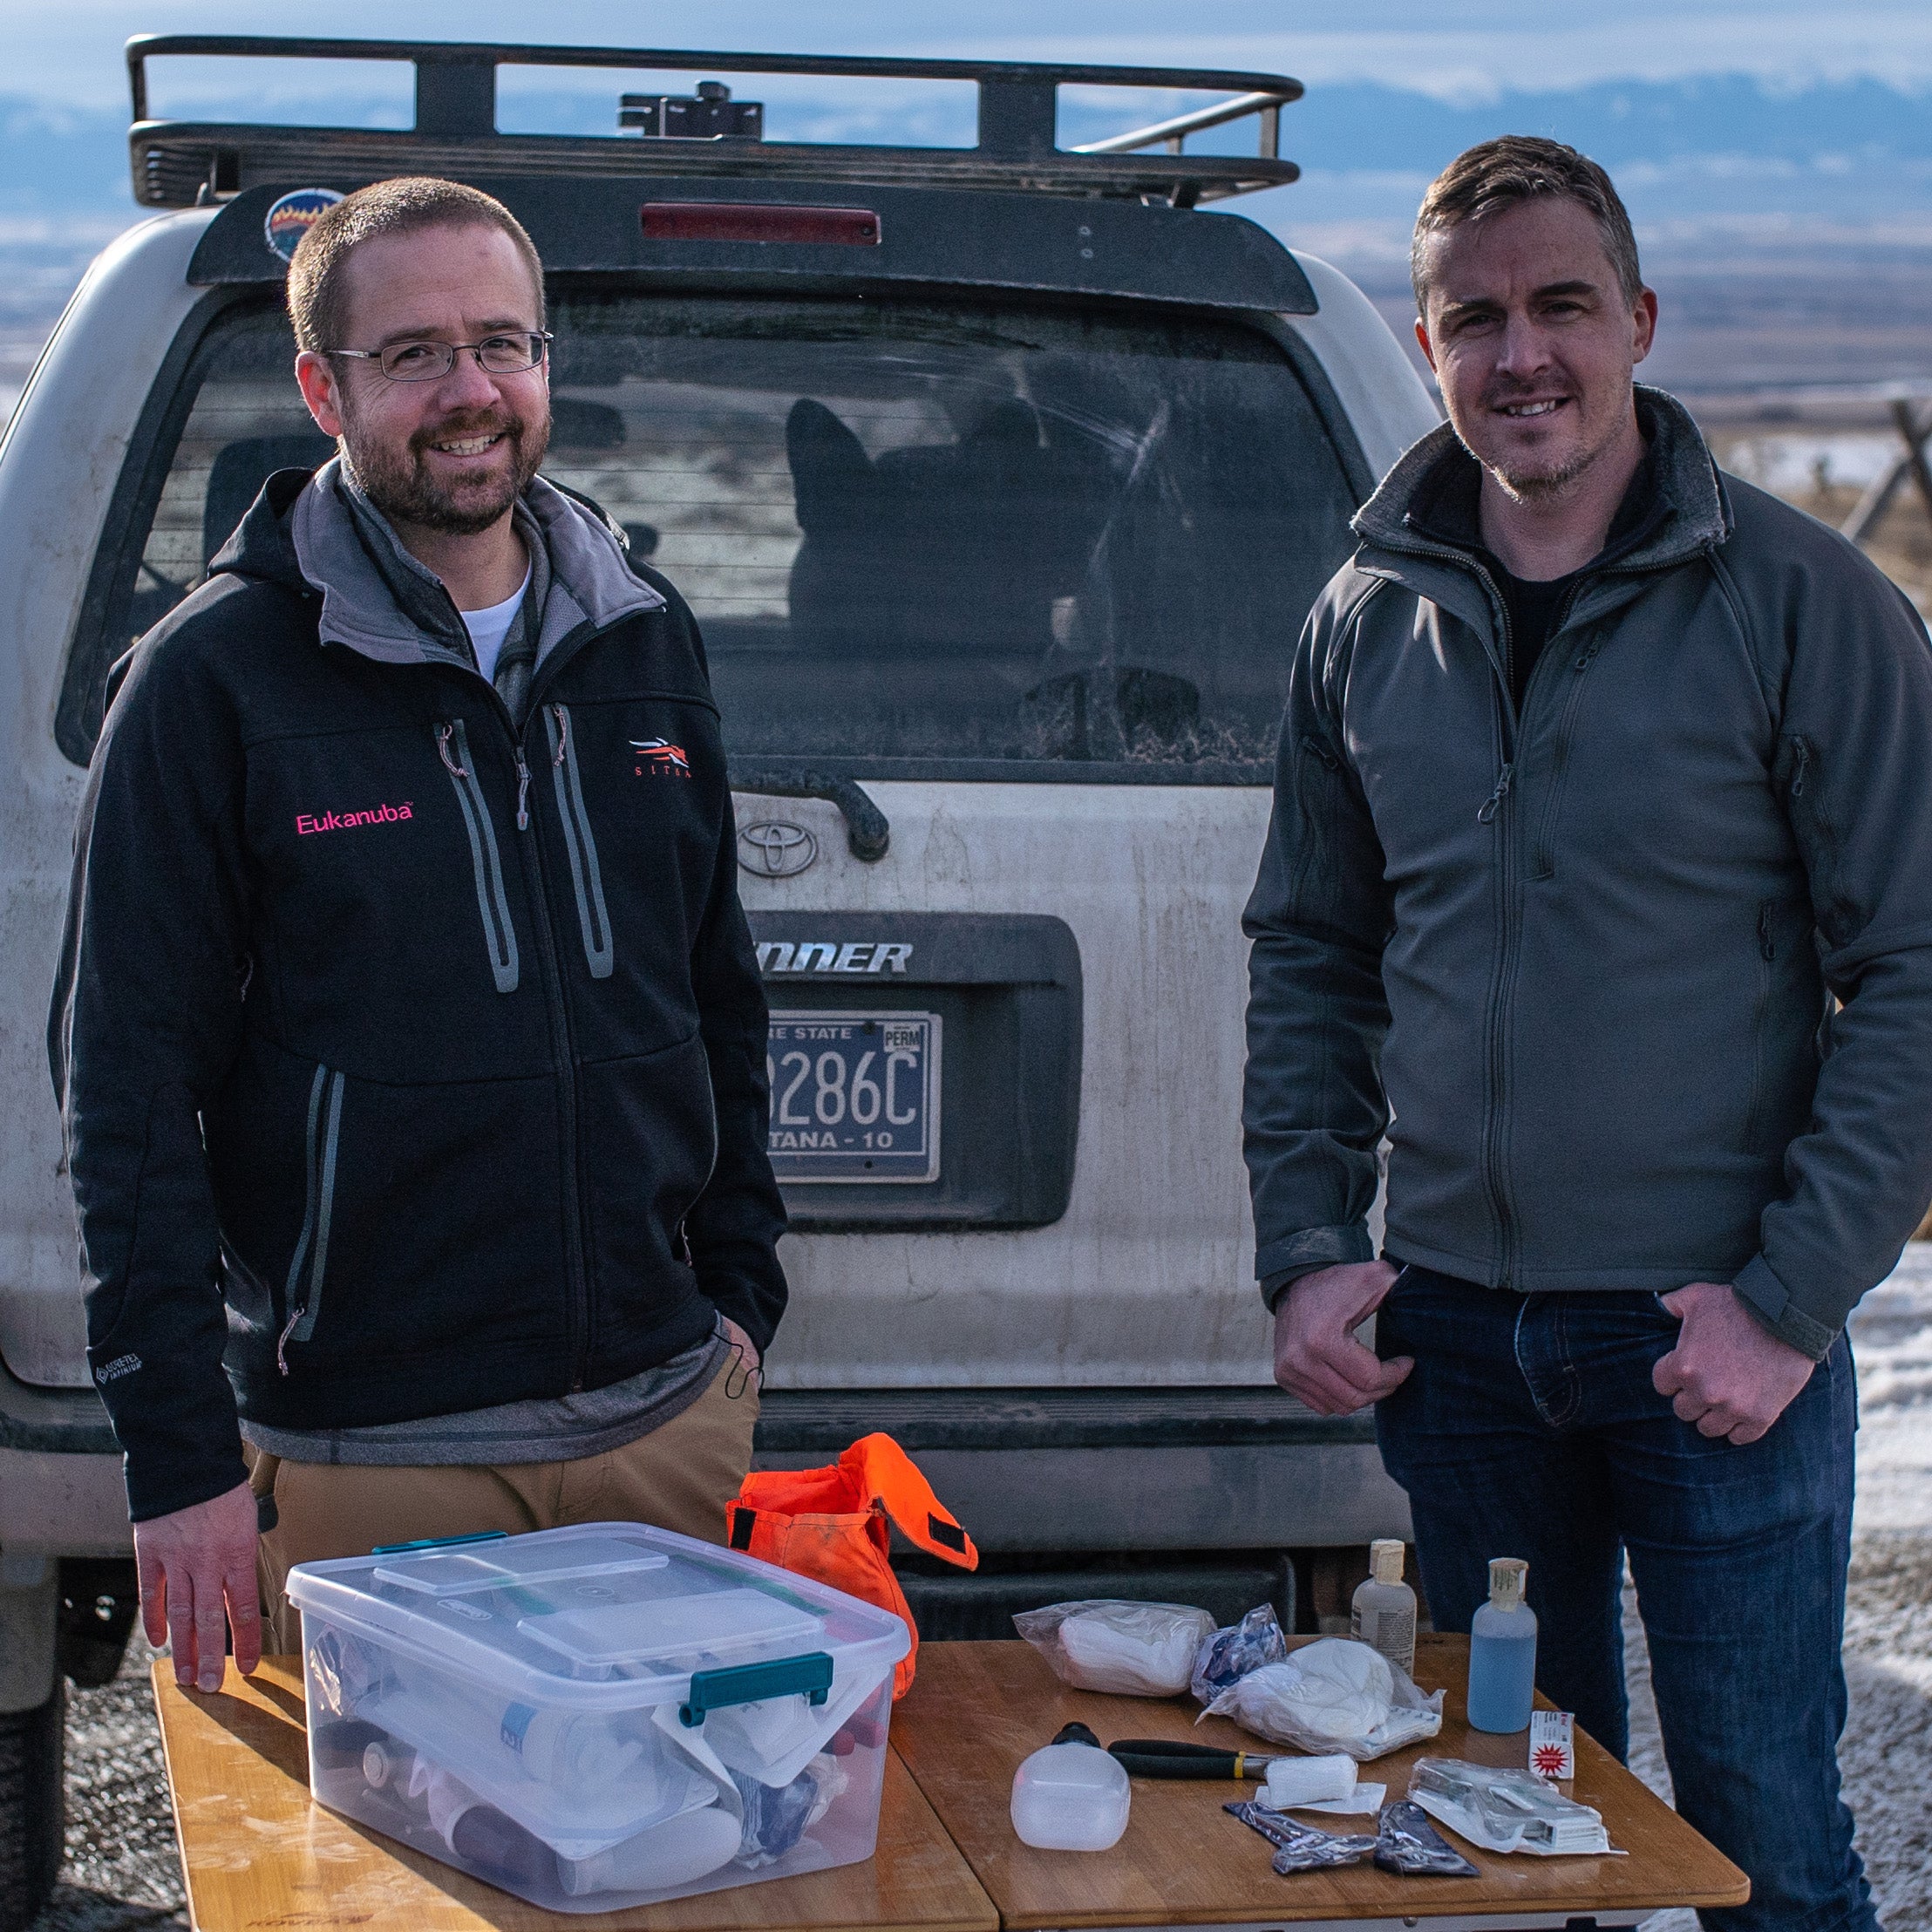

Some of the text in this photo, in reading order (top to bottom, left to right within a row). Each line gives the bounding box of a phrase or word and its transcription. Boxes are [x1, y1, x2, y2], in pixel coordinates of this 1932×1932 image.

[635, 765, 692, 779] SITKA
[296, 803, 413, 834] Eukanuba
[794, 1027, 853, 1039] STATE
[885, 1031, 921, 1046] PERM
[767, 1051, 917, 1125] 286C
